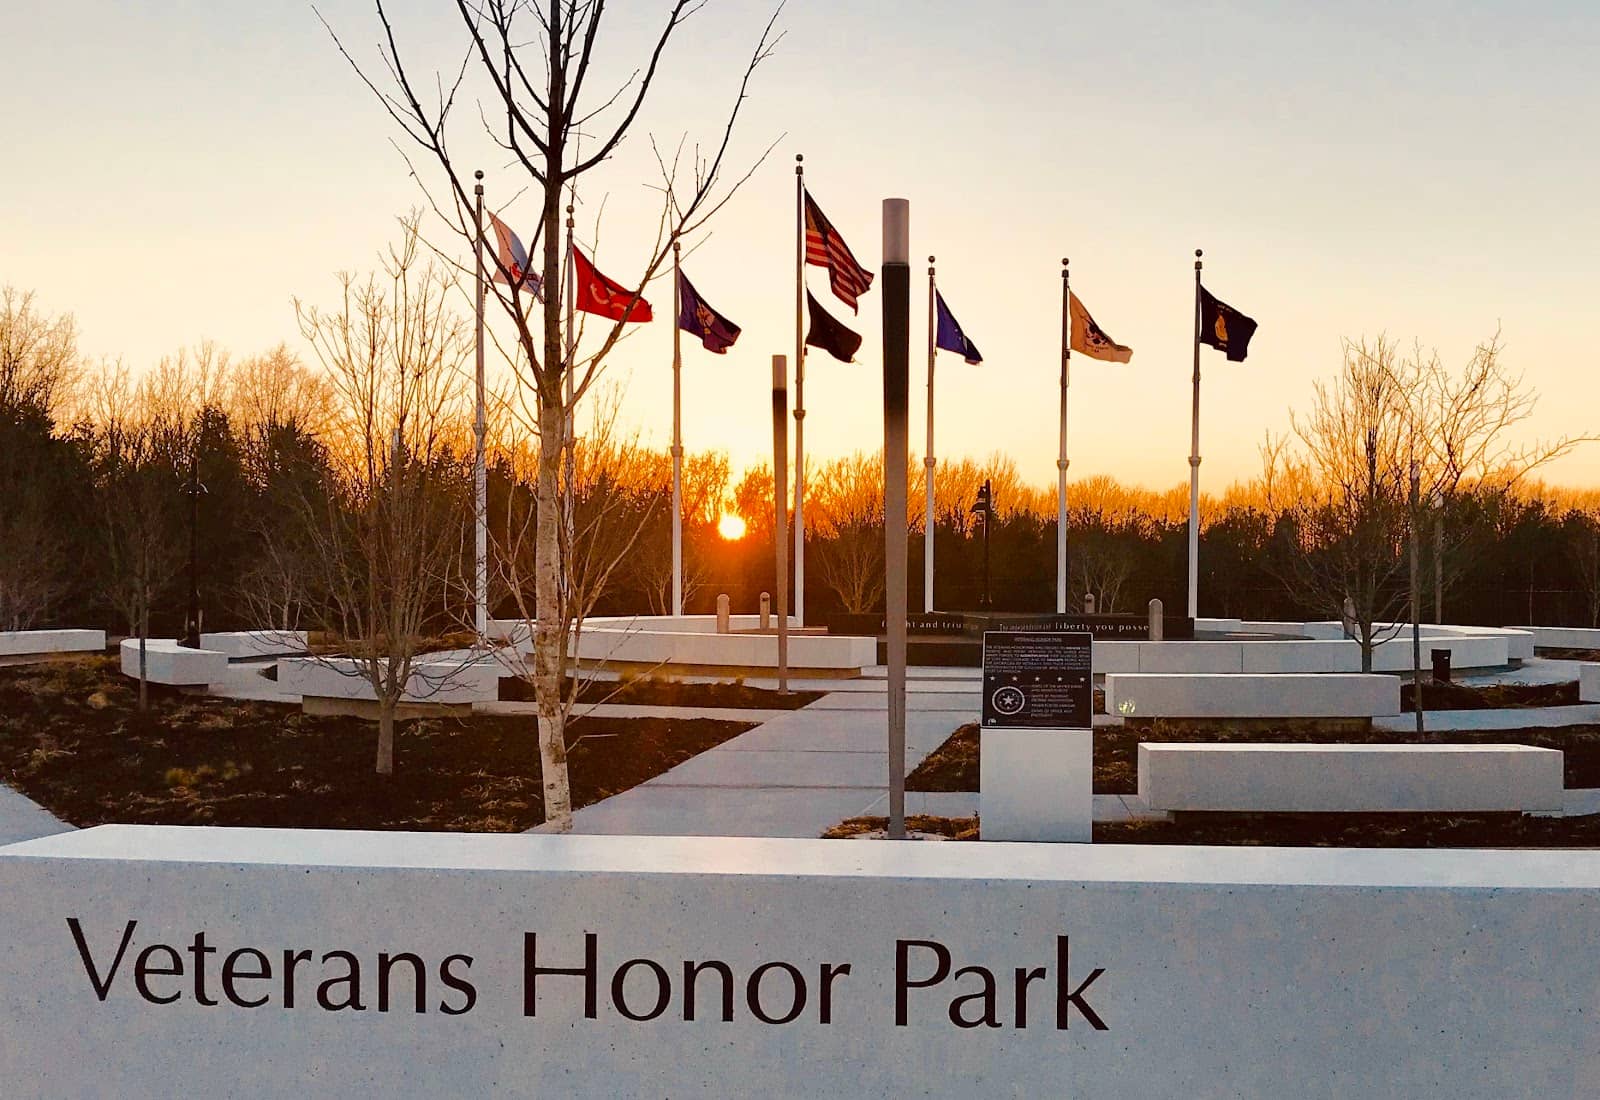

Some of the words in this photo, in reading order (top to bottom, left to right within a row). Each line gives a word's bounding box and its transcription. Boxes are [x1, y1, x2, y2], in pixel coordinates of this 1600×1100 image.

[919, 620, 938, 629] and
[1055, 621, 1091, 631] liberty
[1118, 624, 1150, 632] posse
[66, 917, 477, 1016] Veterans
[523, 931, 852, 1025] Honor
[895, 934, 1110, 1031] Park
